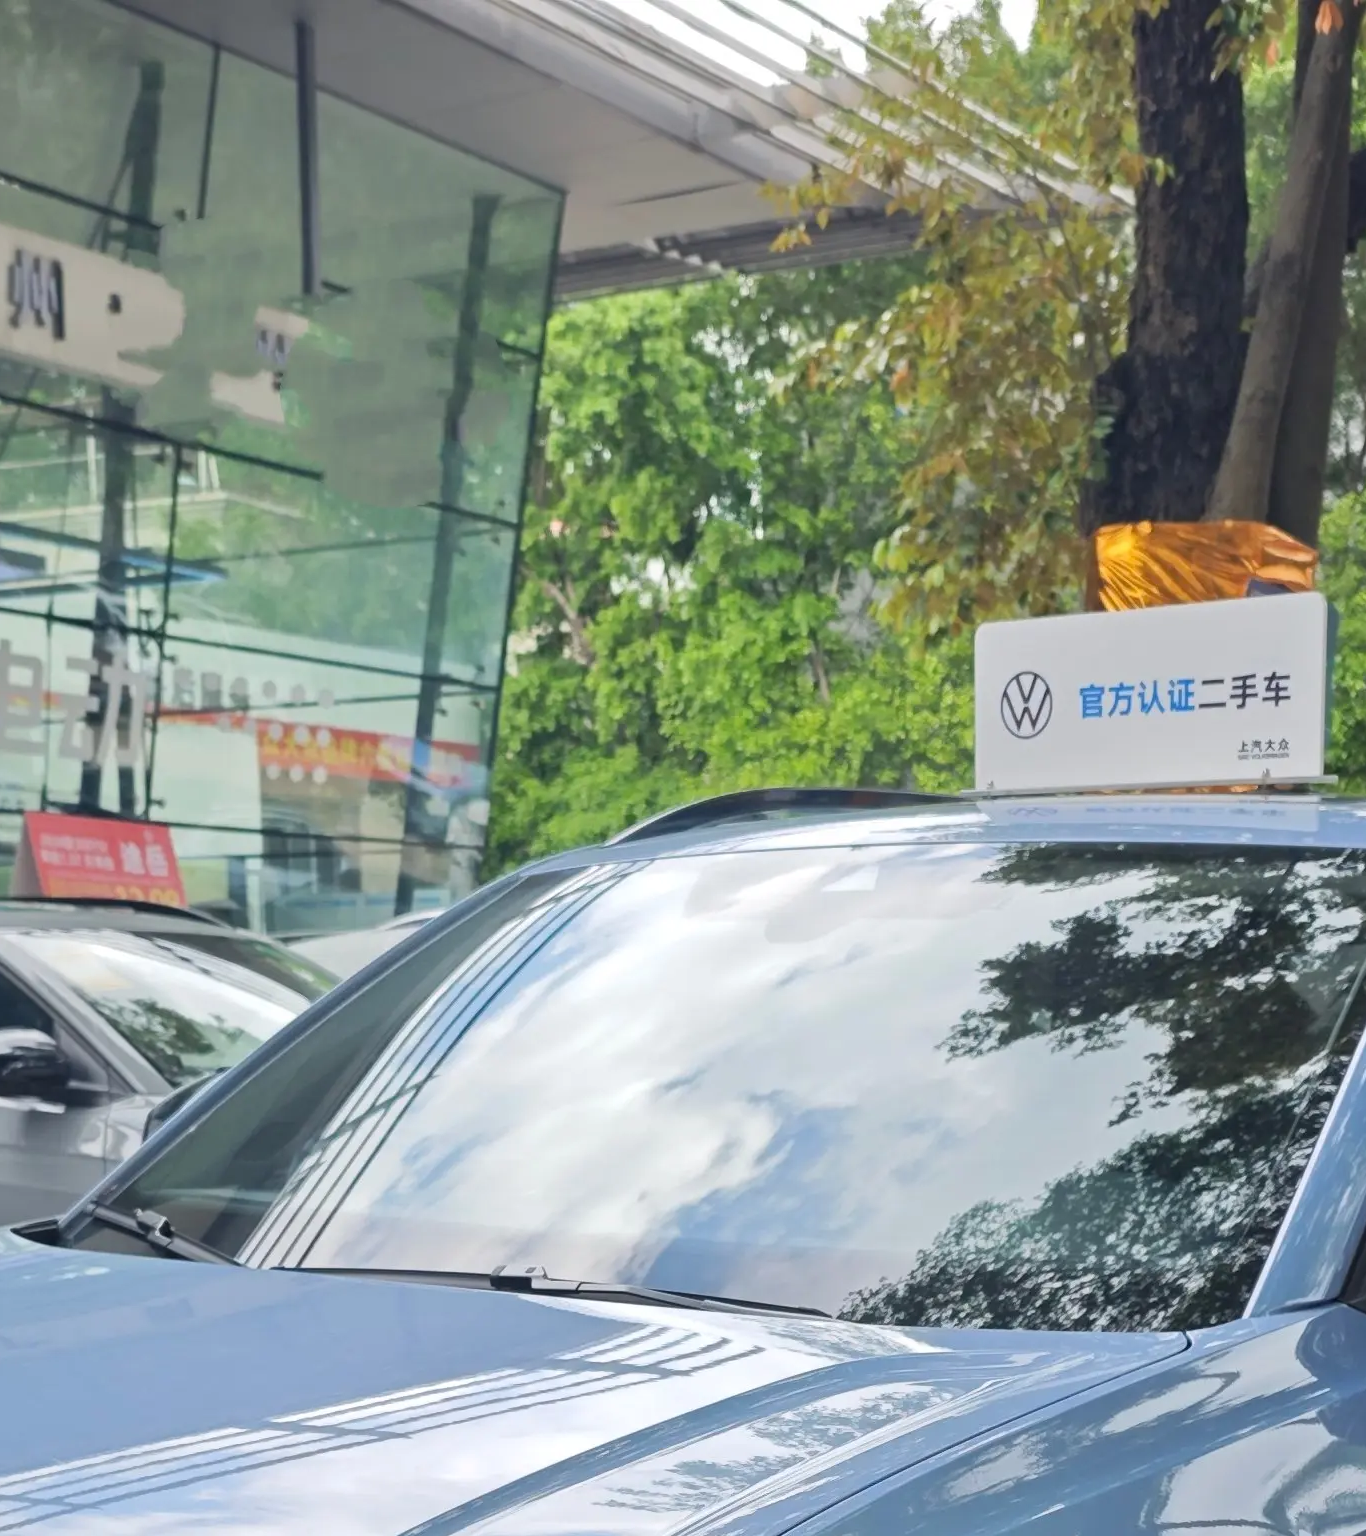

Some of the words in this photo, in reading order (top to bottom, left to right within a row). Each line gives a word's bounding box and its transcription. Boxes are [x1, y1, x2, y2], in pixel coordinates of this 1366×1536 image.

[1078, 670, 1293, 720] 官方认证二手车
[1237, 737, 1291, 753] 上汽大众
